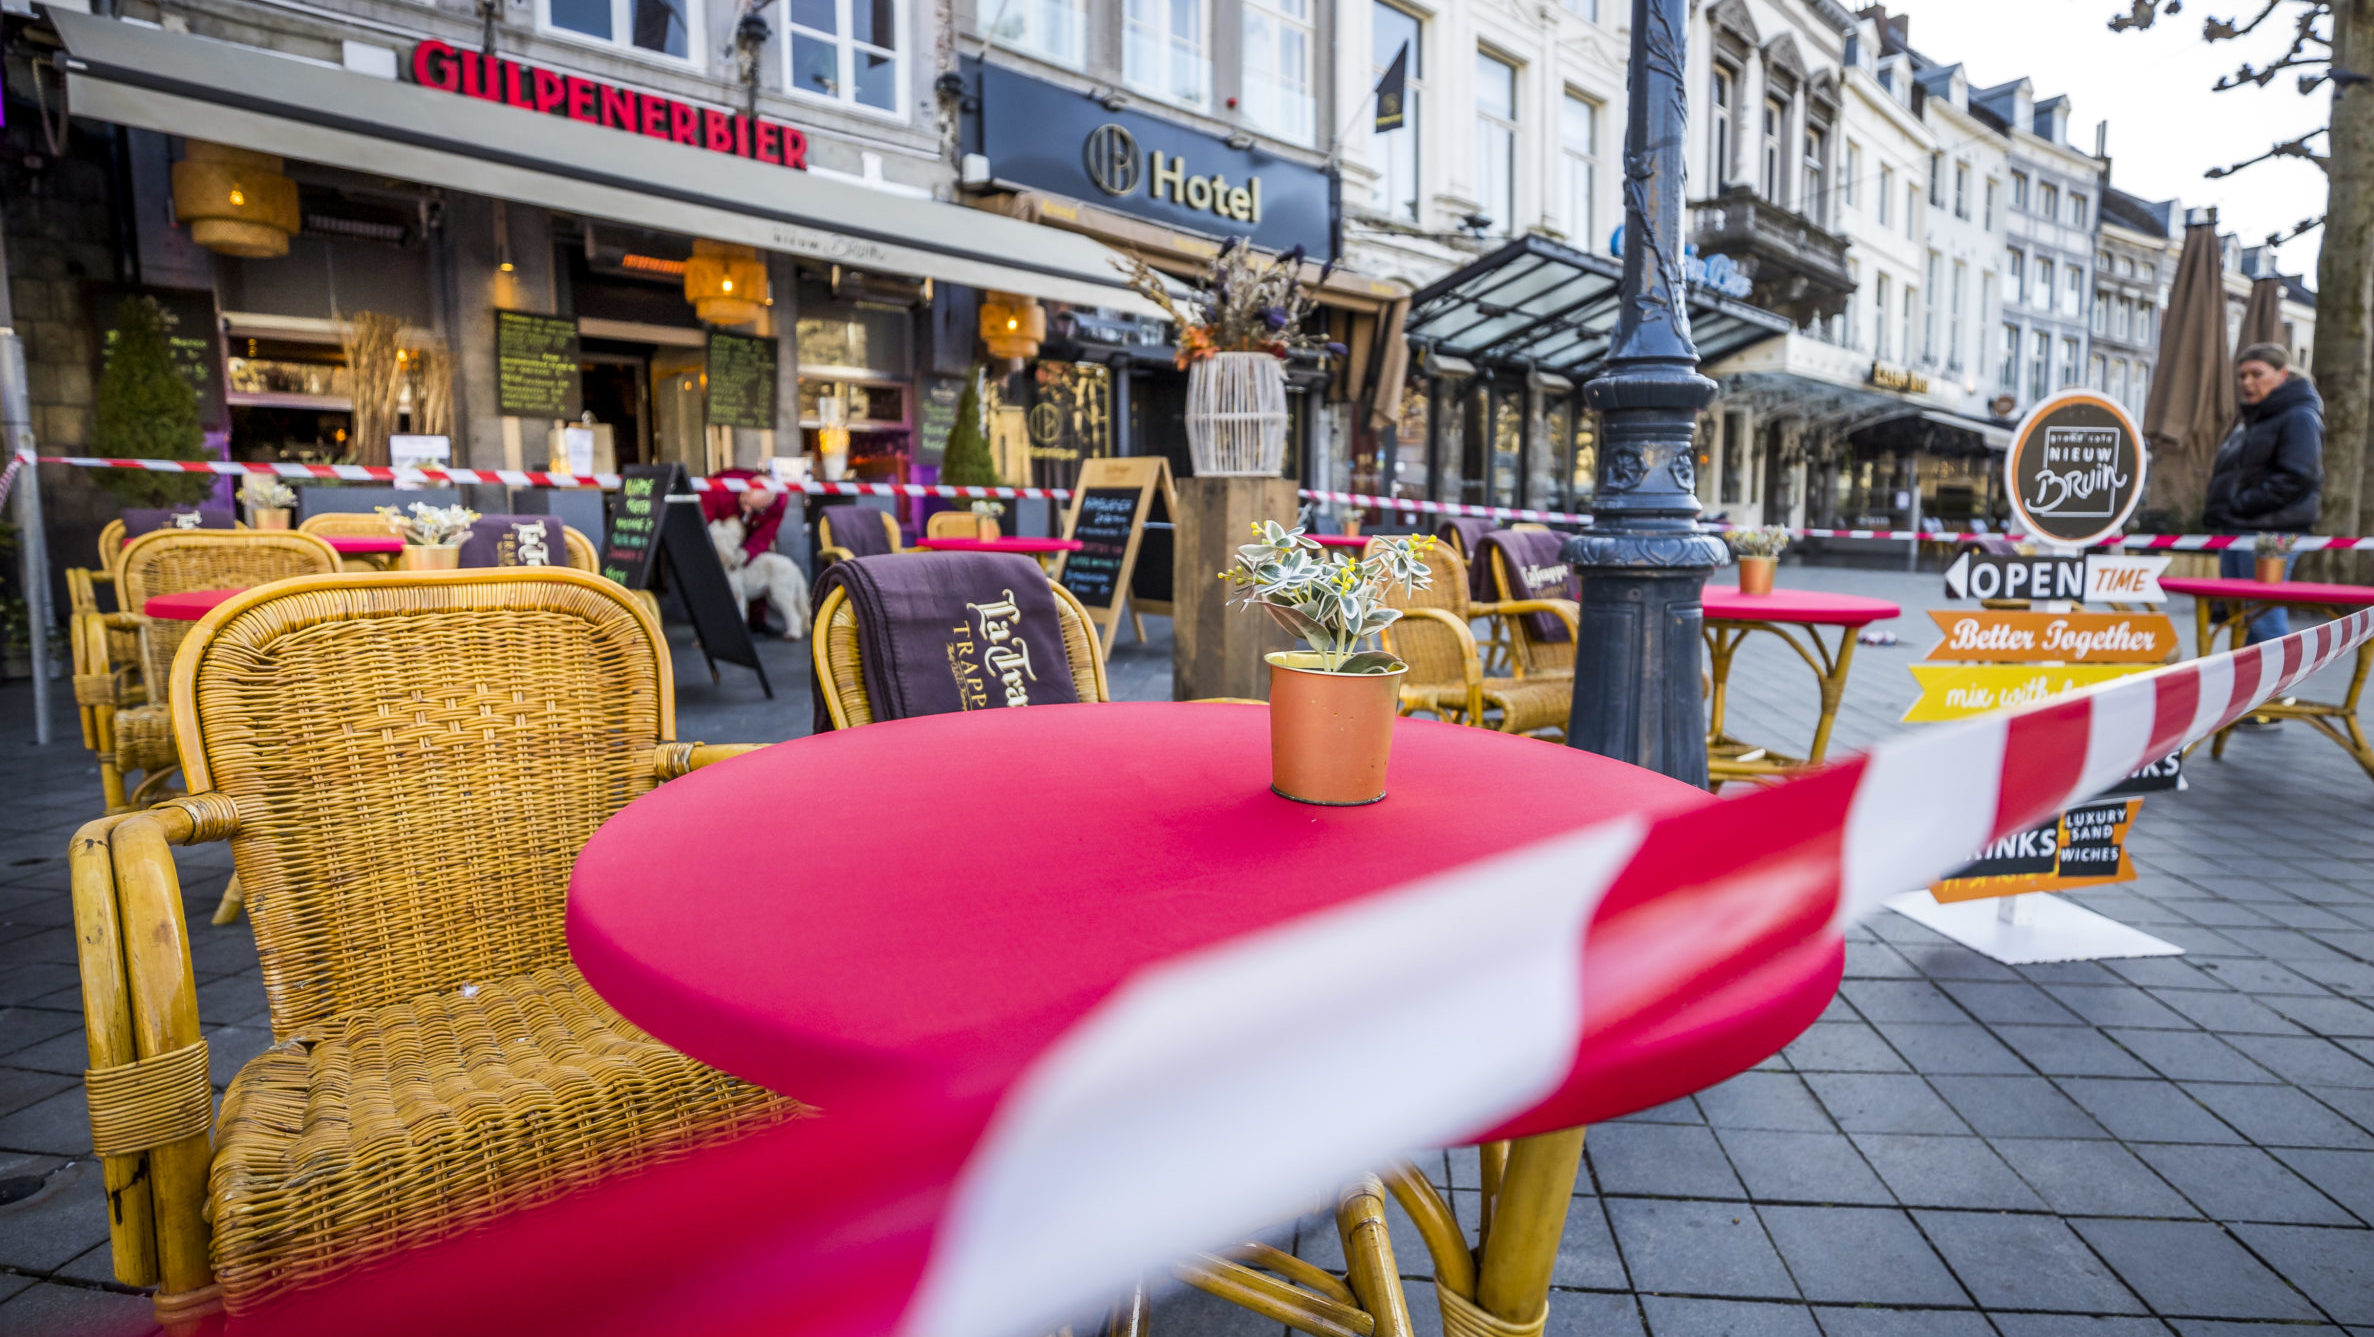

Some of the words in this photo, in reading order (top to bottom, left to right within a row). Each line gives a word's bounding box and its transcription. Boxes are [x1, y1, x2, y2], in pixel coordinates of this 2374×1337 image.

[1153, 150, 1262, 223] Hotel
[2048, 446, 2112, 462] NIEUW
[1970, 562, 2084, 599] OPEN
[2095, 568, 2150, 592] TIME
[1950, 618, 2036, 650] Better
[2041, 620, 2156, 660] Together
[953, 620, 987, 708] TRAPP
[1945, 681, 1995, 708] mix
[2065, 809, 2127, 829] LUXURY
[2070, 825, 2113, 843] SAND
[1965, 828, 2058, 861] INKS
[2060, 846, 2119, 864] WICHES
